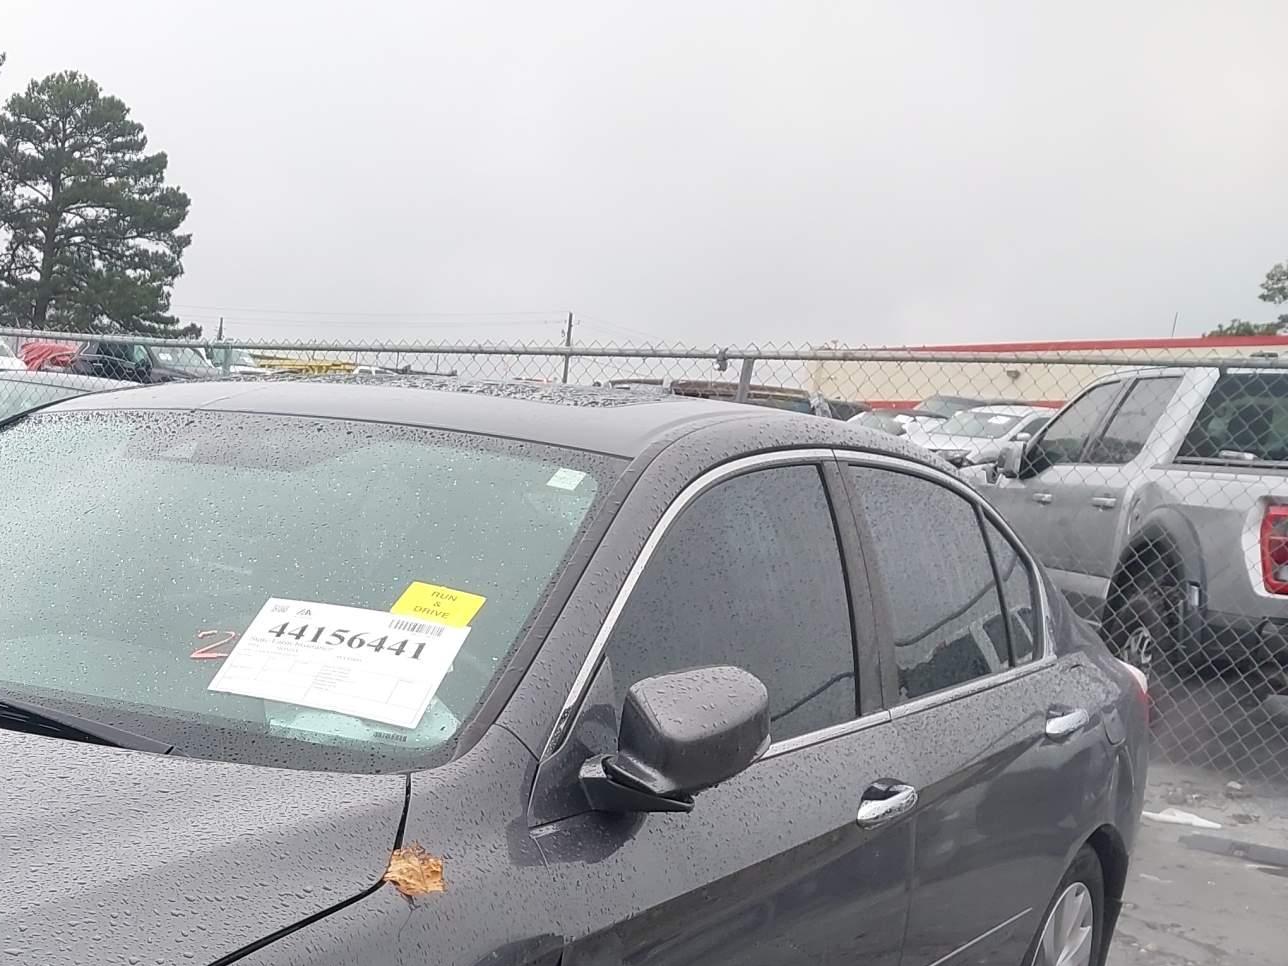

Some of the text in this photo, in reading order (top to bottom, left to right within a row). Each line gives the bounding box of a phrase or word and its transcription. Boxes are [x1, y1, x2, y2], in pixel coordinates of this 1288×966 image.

[431, 591, 458, 602] RUN
[413, 605, 451, 619] DRIVE
[190, 629, 235, 658] 2
[268, 621, 428, 660] 44156441
